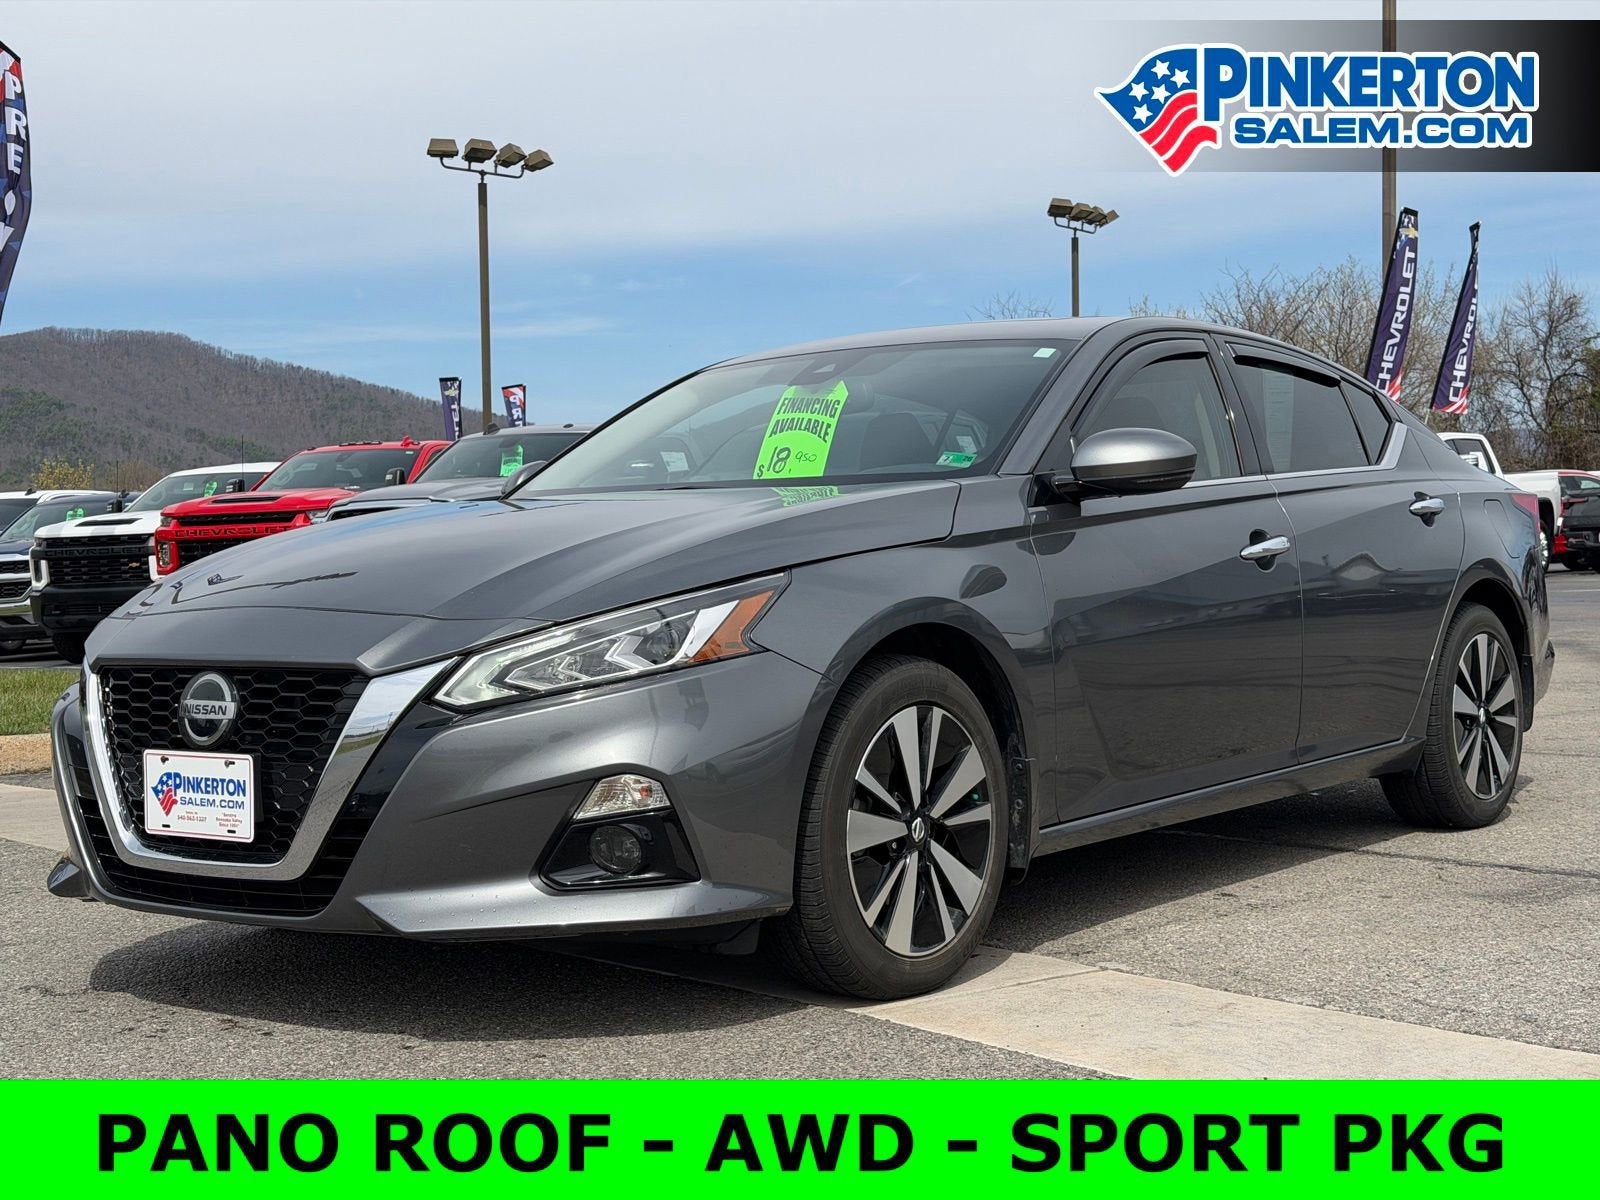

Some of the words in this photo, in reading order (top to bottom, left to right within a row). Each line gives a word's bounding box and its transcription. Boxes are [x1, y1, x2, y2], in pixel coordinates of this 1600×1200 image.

[1376, 247, 1416, 392] CHEVROLET
[776, 397, 841, 419] FINANCING
[768, 417, 832, 443] AVAILABLE
[174, 526, 292, 538] CHEVROLET
[182, 703, 228, 716] NISSAN
[173, 771, 247, 798] PINKERTON
[180, 796, 245, 810] SALEM.COM
